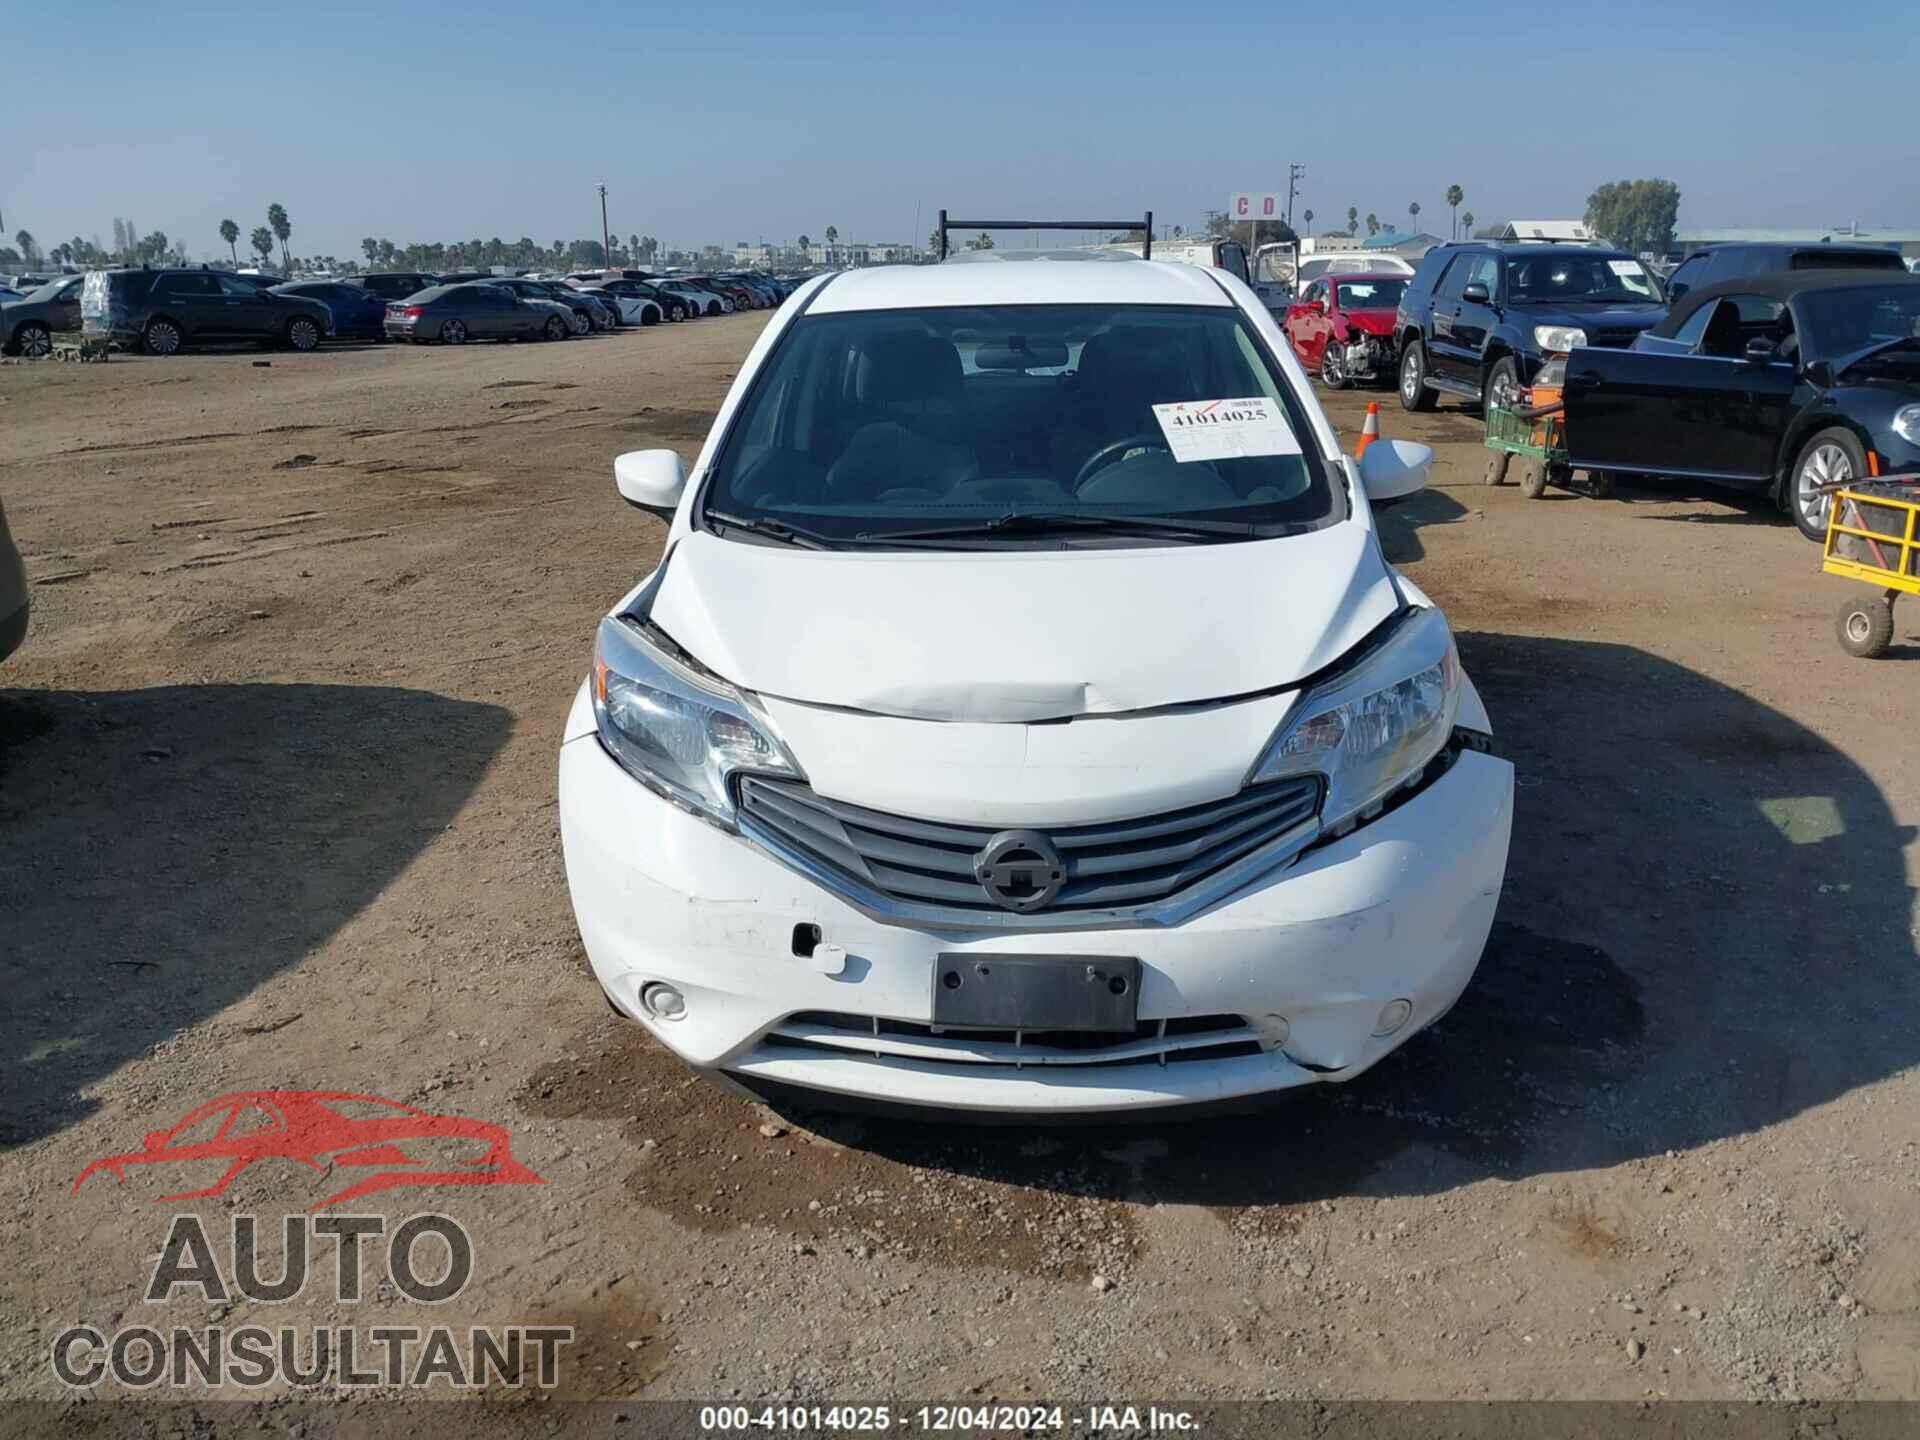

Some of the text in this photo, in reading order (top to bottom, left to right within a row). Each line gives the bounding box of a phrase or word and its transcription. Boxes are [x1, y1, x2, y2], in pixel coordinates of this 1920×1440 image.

[1238, 197, 1274, 215] C D
[1172, 409, 1268, 426] 41014025
